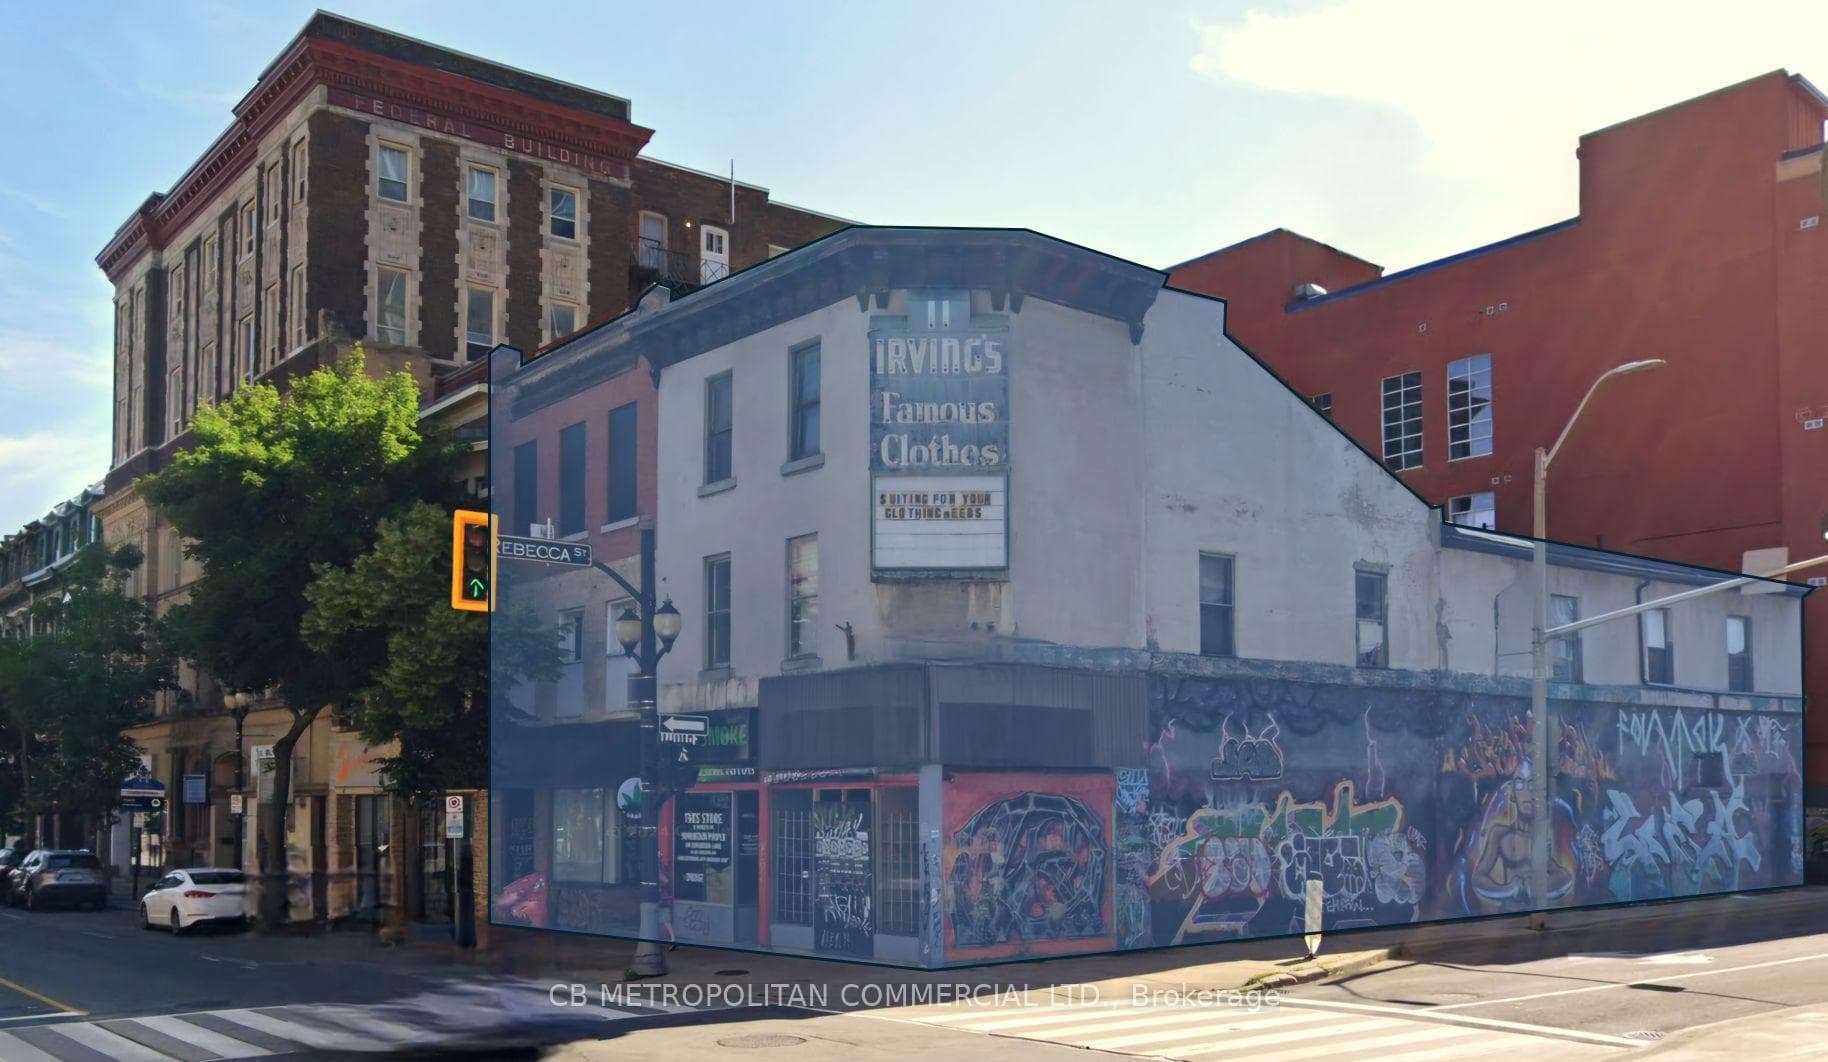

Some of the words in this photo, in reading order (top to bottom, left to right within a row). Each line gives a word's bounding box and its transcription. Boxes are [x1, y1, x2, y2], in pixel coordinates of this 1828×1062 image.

[355, 96, 471, 137] FEDERAL
[504, 133, 611, 175] BUILDING
[881, 391, 996, 424] Famous
[881, 433, 1000, 468] Clothes
[933, 493, 956, 505] FOR
[963, 493, 991, 505] YOUR
